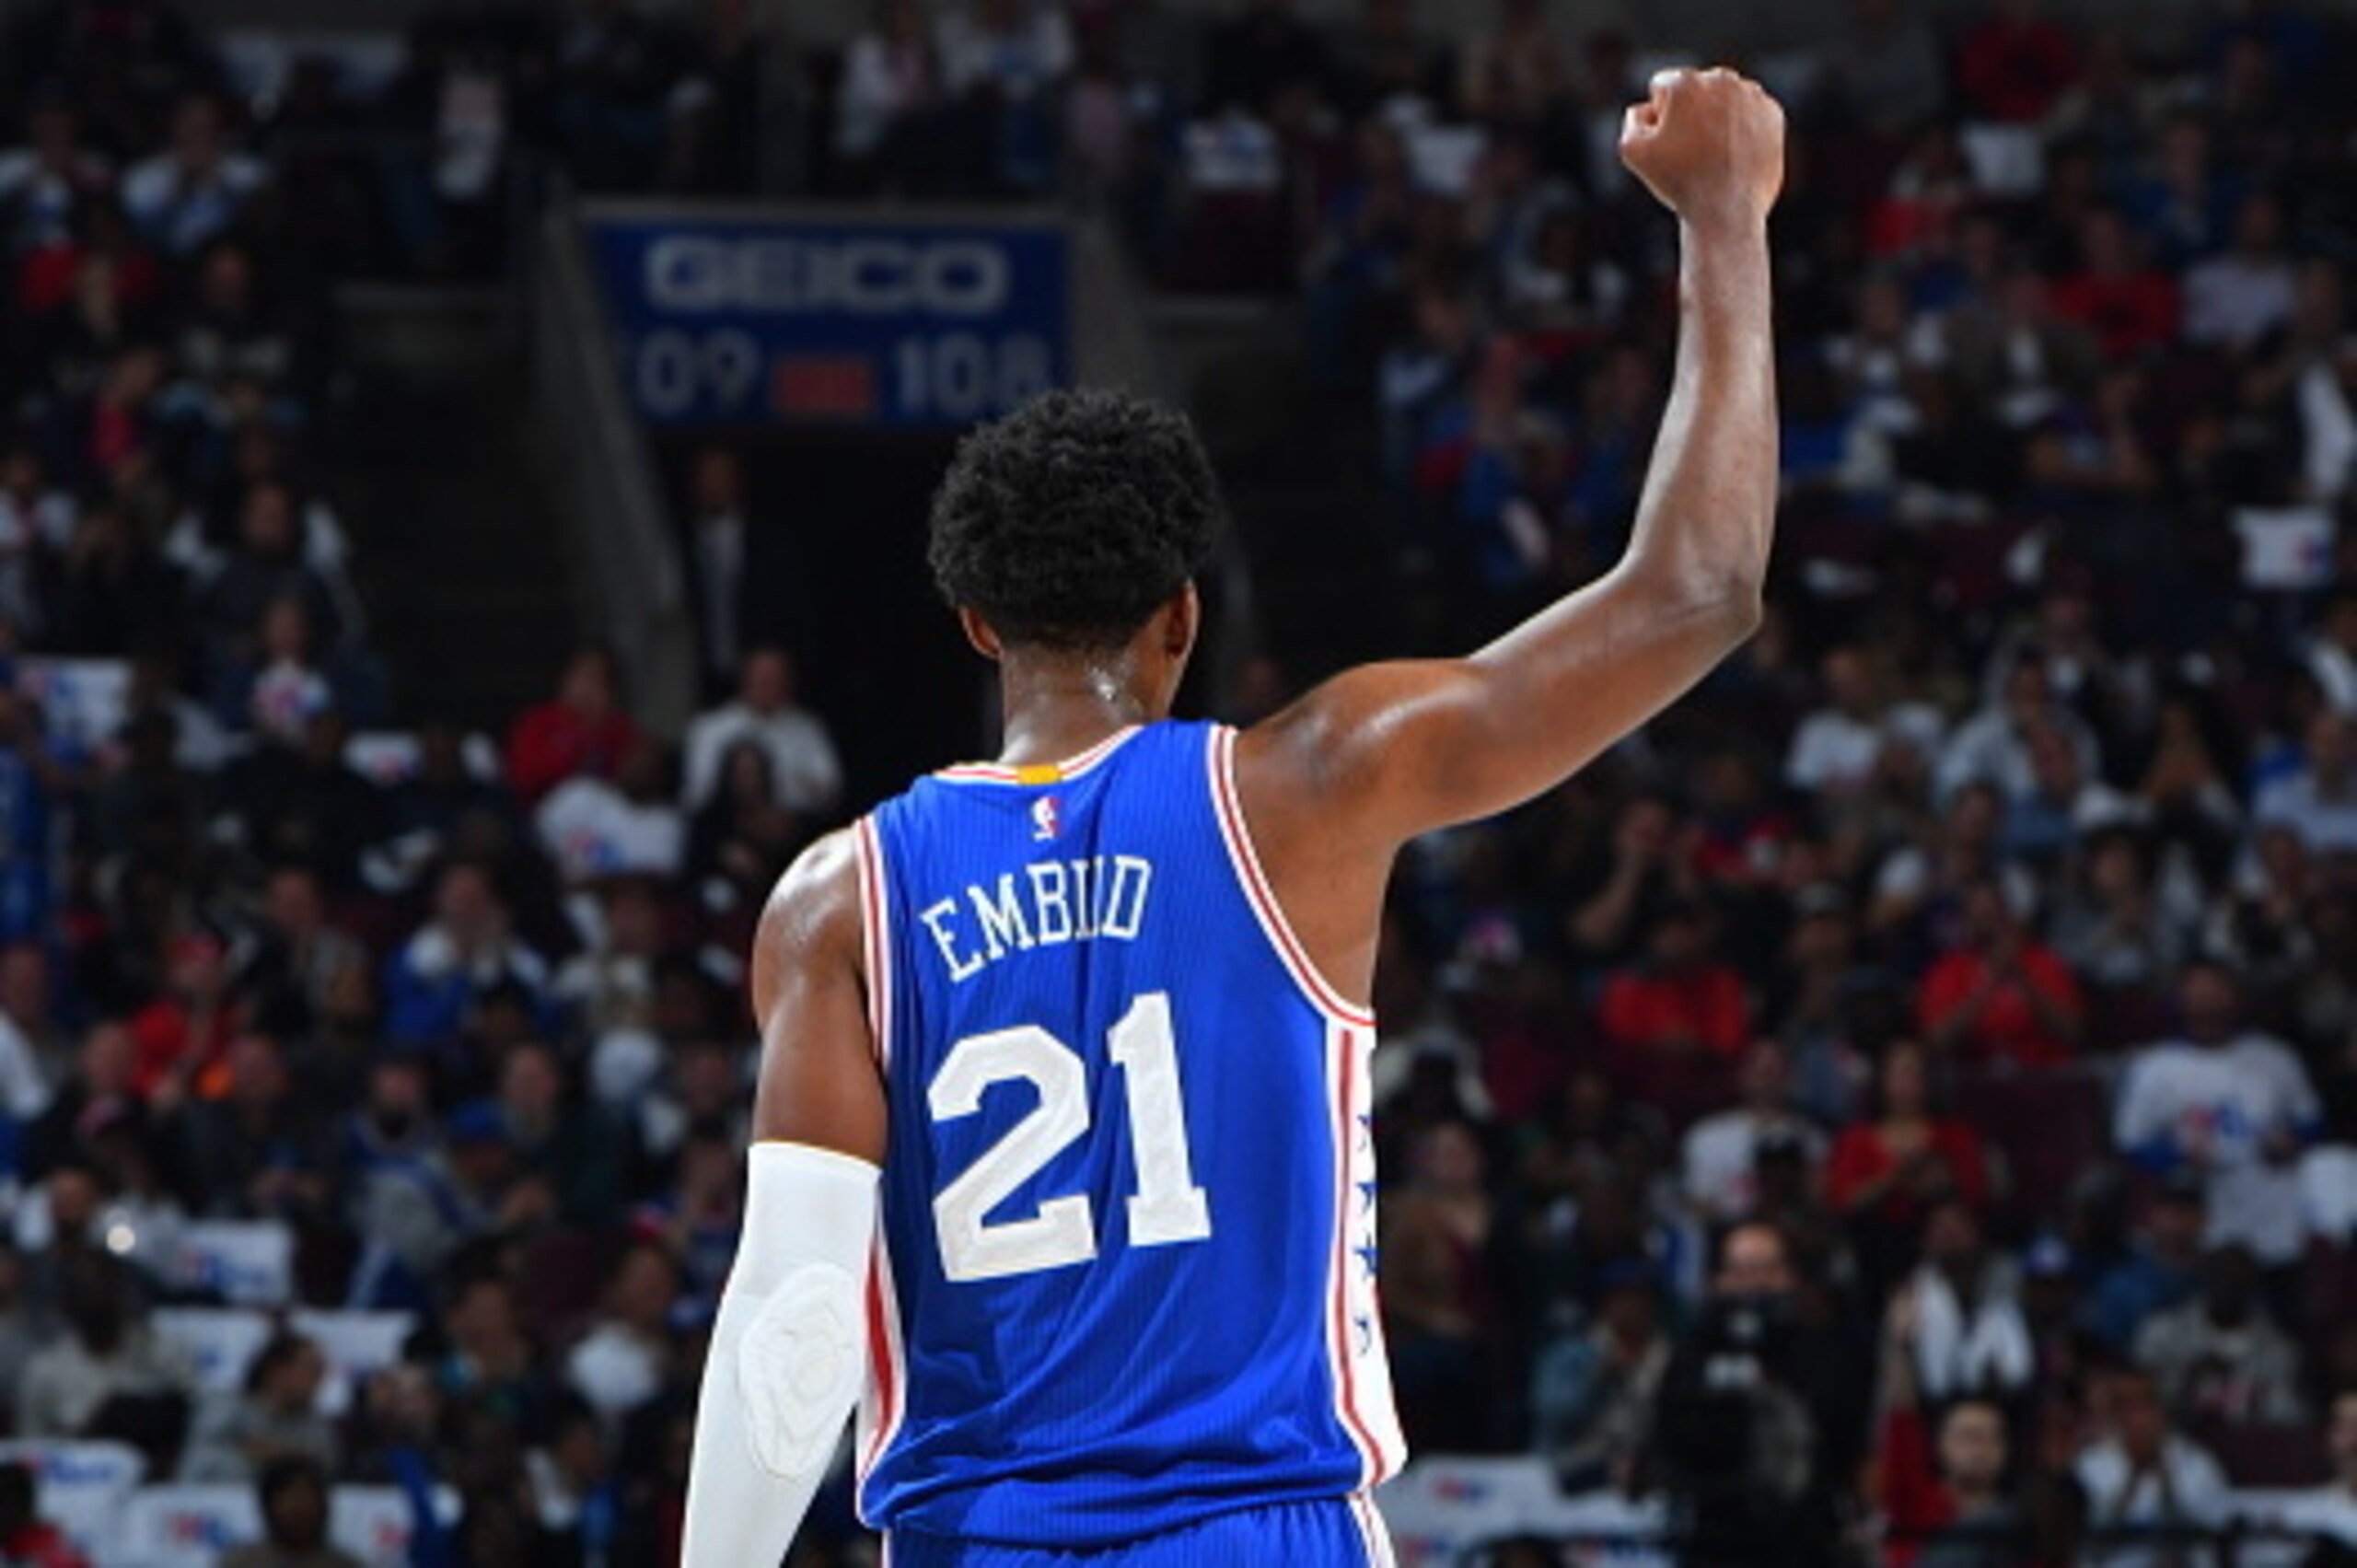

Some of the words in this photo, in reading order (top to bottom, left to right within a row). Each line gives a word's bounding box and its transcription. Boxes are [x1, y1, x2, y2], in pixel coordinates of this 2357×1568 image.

[644, 235, 1010, 318] GEICO
[628, 326, 761, 419] 09
[926, 989, 1212, 1283] 21
